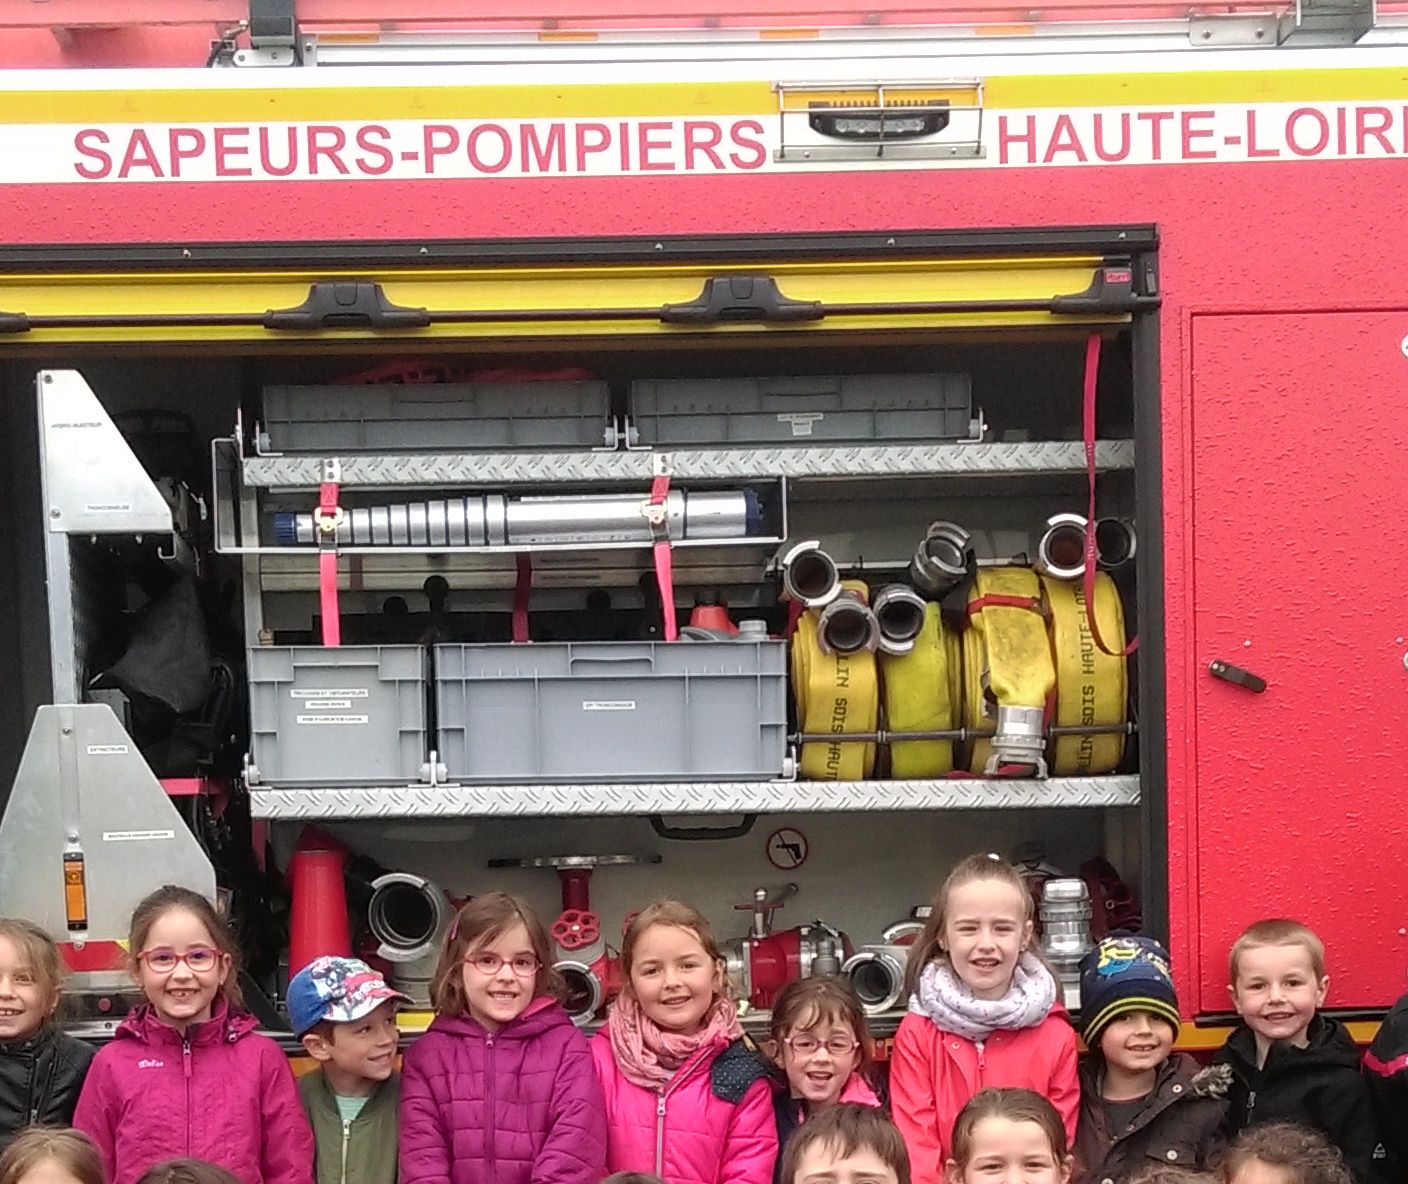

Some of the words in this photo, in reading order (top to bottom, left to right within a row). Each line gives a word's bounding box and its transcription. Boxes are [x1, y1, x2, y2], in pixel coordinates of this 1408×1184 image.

[73, 119, 768, 180] SAPEURS-POMPIERS
[831, 697, 848, 733] SDIS
[1081, 684, 1095, 727] SDIS
[825, 741, 841, 780] HAUT
